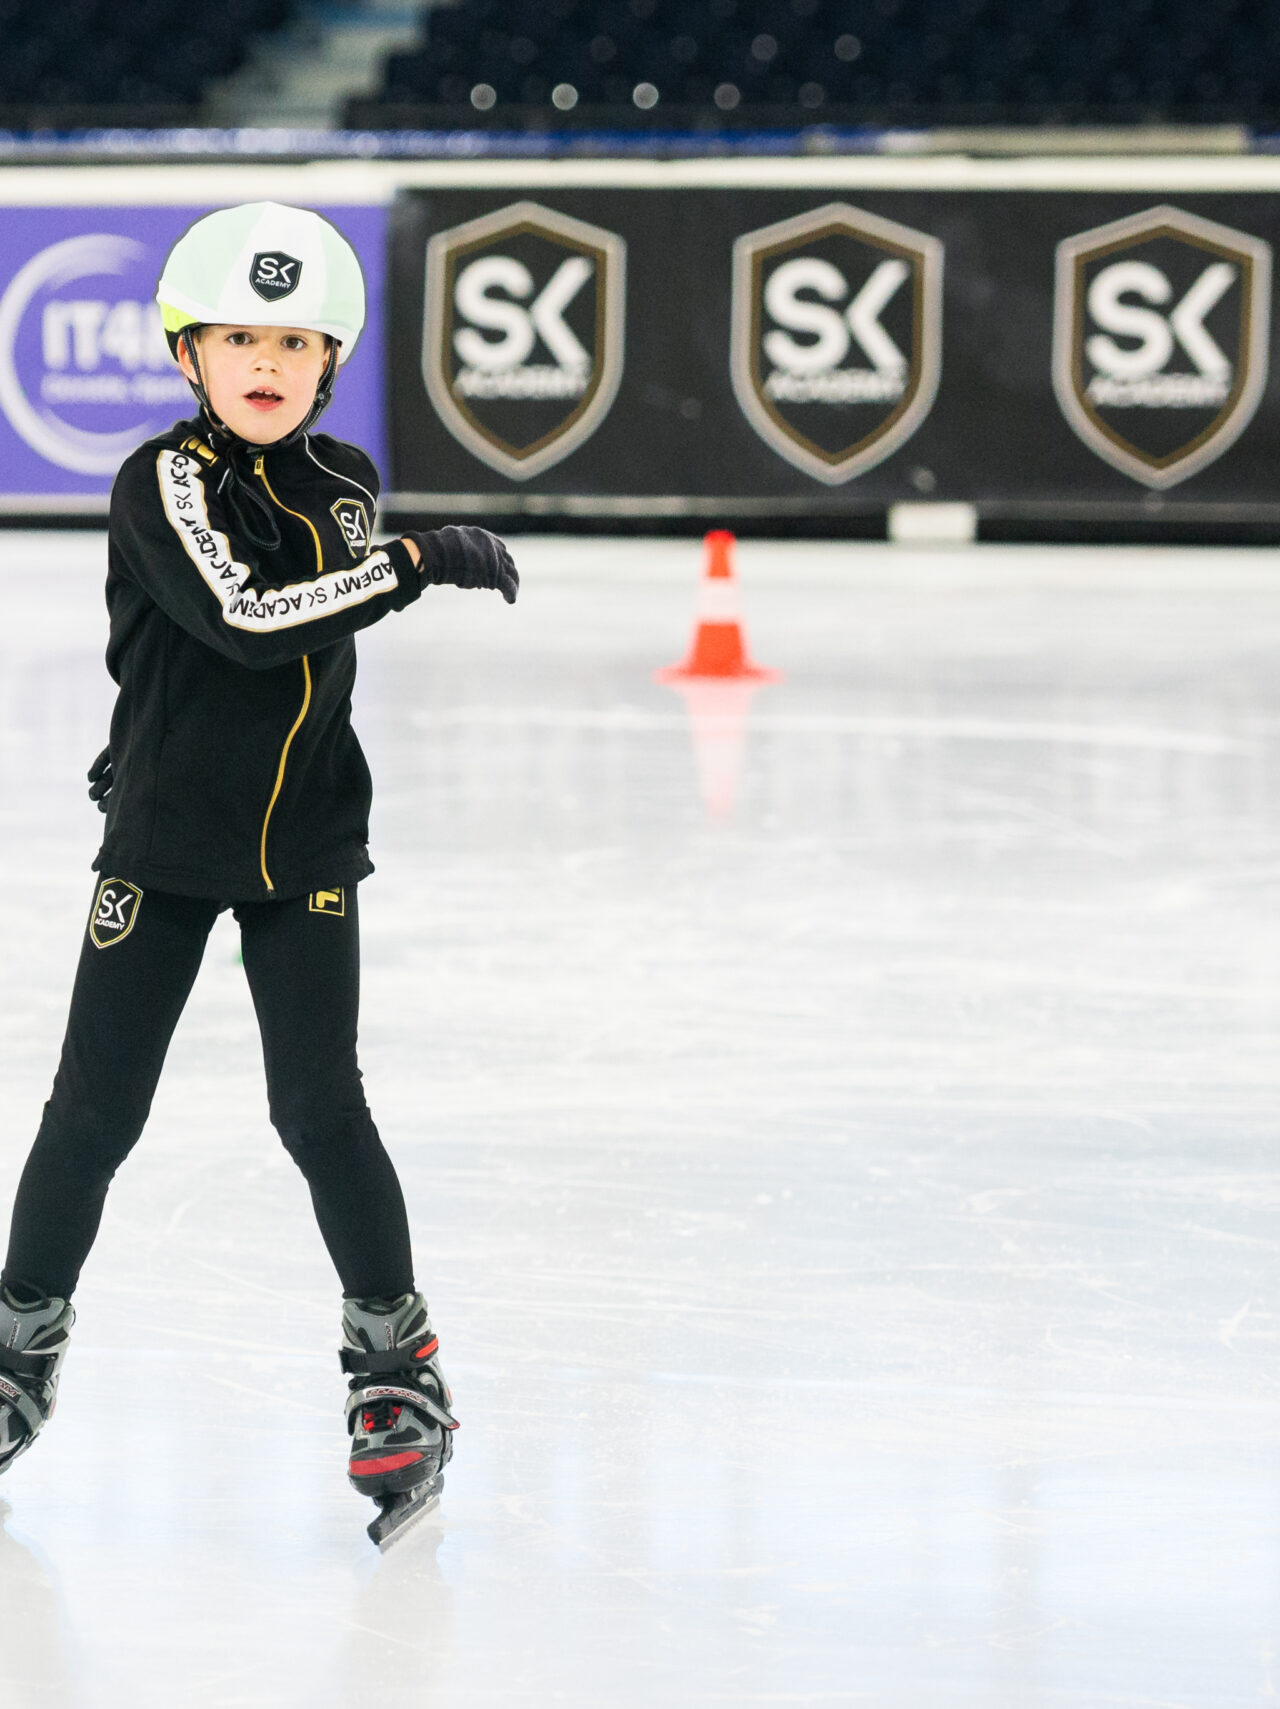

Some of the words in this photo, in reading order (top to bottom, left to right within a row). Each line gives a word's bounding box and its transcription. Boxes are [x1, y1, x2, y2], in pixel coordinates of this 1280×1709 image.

[255, 277, 291, 289] ACADEMY
[257, 257, 296, 284] SK
[453, 255, 594, 372] SK
[763, 257, 910, 377] SK
[1086, 260, 1237, 382] SK
[42, 300, 176, 371] IT4K
[170, 454, 191, 489] ACAD
[174, 492, 194, 510] SK
[340, 509, 366, 540] SK
[334, 562, 393, 600] ADEMY
[94, 917, 126, 931] ACADEMY
[98, 889, 133, 924] SK
